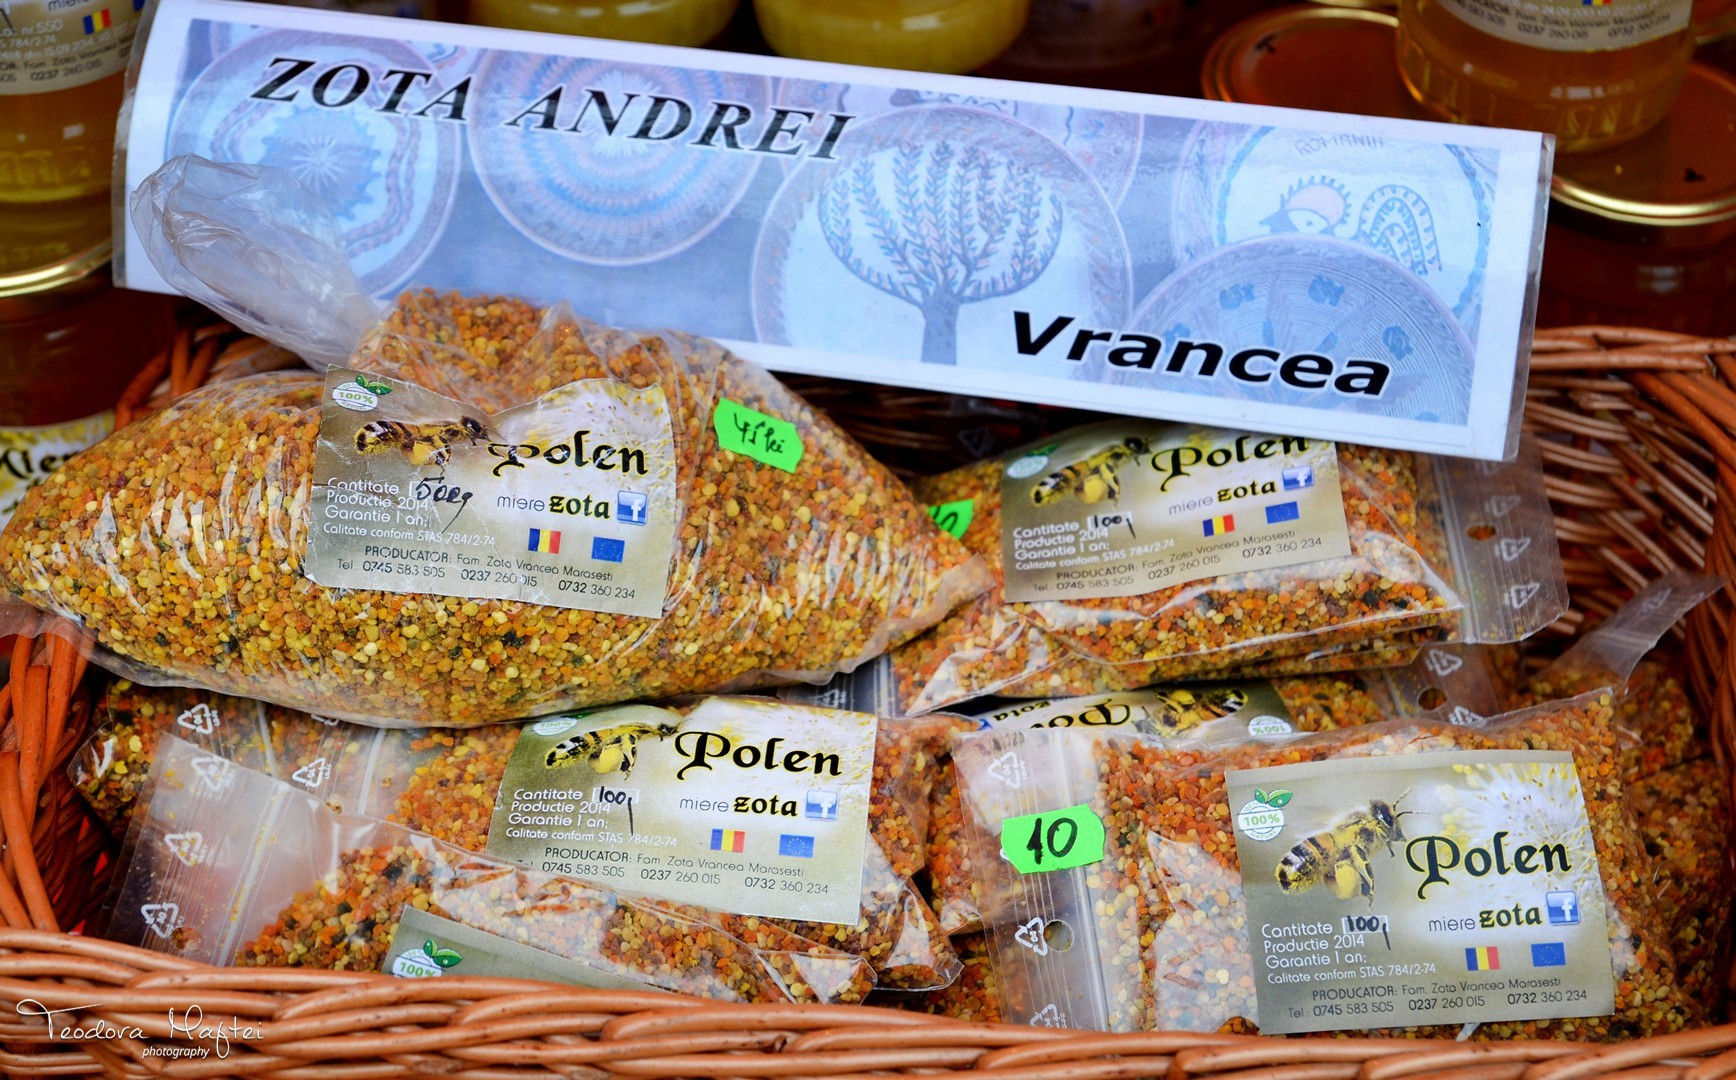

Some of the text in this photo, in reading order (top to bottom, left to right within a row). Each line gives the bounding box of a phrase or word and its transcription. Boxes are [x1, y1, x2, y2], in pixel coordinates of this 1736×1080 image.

[250, 57, 857, 160] ZOTA ANDREI
[1013, 310, 1391, 396] Vrancea
[1151, 435, 1310, 492] Polen
[327, 477, 401, 496] Cantitate
[1168, 496, 1214, 517] miere
[1217, 479, 1278, 502] zota
[326, 489, 429, 511] Productie 2014
[497, 494, 546, 513] miere
[548, 494, 611, 520] zota
[325, 504, 391, 523] Garantie
[323, 522, 496, 547] Calitate conform STAS 784/2-74
[1013, 521, 1080, 540] Cantitate
[1013, 528, 1109, 550] Productie 2014
[364, 545, 614, 582] PRODUCATOR: Fam. Zota Vrancea Marasesti
[1014, 545, 1076, 561] Garantie
[1015, 538, 1175, 571] Calitate conform STAS 784/2-74
[1056, 564, 1138, 581] PRODUCATOR:
[1169, 551, 1194, 563] Zota
[1195, 540, 1240, 555] Vrancea
[1243, 530, 1296, 546] Marasesti
[1056, 579, 1085, 591] 0745
[1088, 577, 1110, 589] 583
[1113, 575, 1135, 587] 505
[1147, 565, 1175, 581] 0237
[1179, 559, 1200, 572] 260
[1202, 554, 1222, 568] 015
[1242, 545, 1273, 559] 0732
[1276, 541, 1299, 554] 360
[1301, 536, 1323, 550] 234
[362, 560, 393, 574] 0745
[396, 563, 419, 576] 583
[423, 566, 446, 578] 505
[460, 568, 491, 582] 0237
[494, 571, 518, 584] 260
[558, 579, 588, 594] 0732
[591, 584, 612, 597] 360
[615, 587, 636, 599] 234
[674, 731, 842, 781] Polen
[513, 788, 583, 801] Cantitate
[679, 795, 798, 818] miere zota
[508, 813, 573, 827] Garantie
[511, 801, 611, 815] Productie 2014
[1243, 813, 1281, 827] 100%
[506, 827, 678, 848] Calitate conform STAS 784/2-74
[1026, 817, 1079, 865] 10
[544, 847, 632, 863] PRODUCATOR:
[667, 855, 694, 868] Zota
[698, 858, 745, 872] Vrancea
[749, 863, 805, 878] Marasesti
[1405, 831, 1573, 900] Polen
[542, 861, 572, 874] 0745
[575, 863, 599, 875] 583
[602, 865, 625, 878] 505
[640, 868, 672, 881] 0237
[675, 871, 699, 884] 260
[701, 872, 721, 885] 015
[744, 876, 776, 890] 0732
[780, 880, 803, 893] 360
[806, 882, 829, 894] 234
[1261, 922, 1334, 939] Cantitate
[1428, 915, 1476, 933] miere
[1478, 903, 1543, 929] zota
[1263, 934, 1365, 954] Productie 2014
[1265, 953, 1331, 969] Garantie
[1267, 962, 1436, 985] Calitate conform STAS 784/2-74
[1312, 976, 1562, 1002] PRODUCATOR: Fam. Zota Vrancea Marasesti
[1312, 1004, 1343, 1018] 0745
[1346, 1002, 1369, 1015] 583
[1371, 1001, 1394, 1013] 505
[1408, 998, 1438, 1011] 0237
[1442, 996, 1464, 1009] 260
[1466, 995, 1486, 1007] 015
[1507, 992, 1538, 1005] 0732
[1540, 991, 1563, 1003] 360
[1566, 989, 1588, 1002] 234
